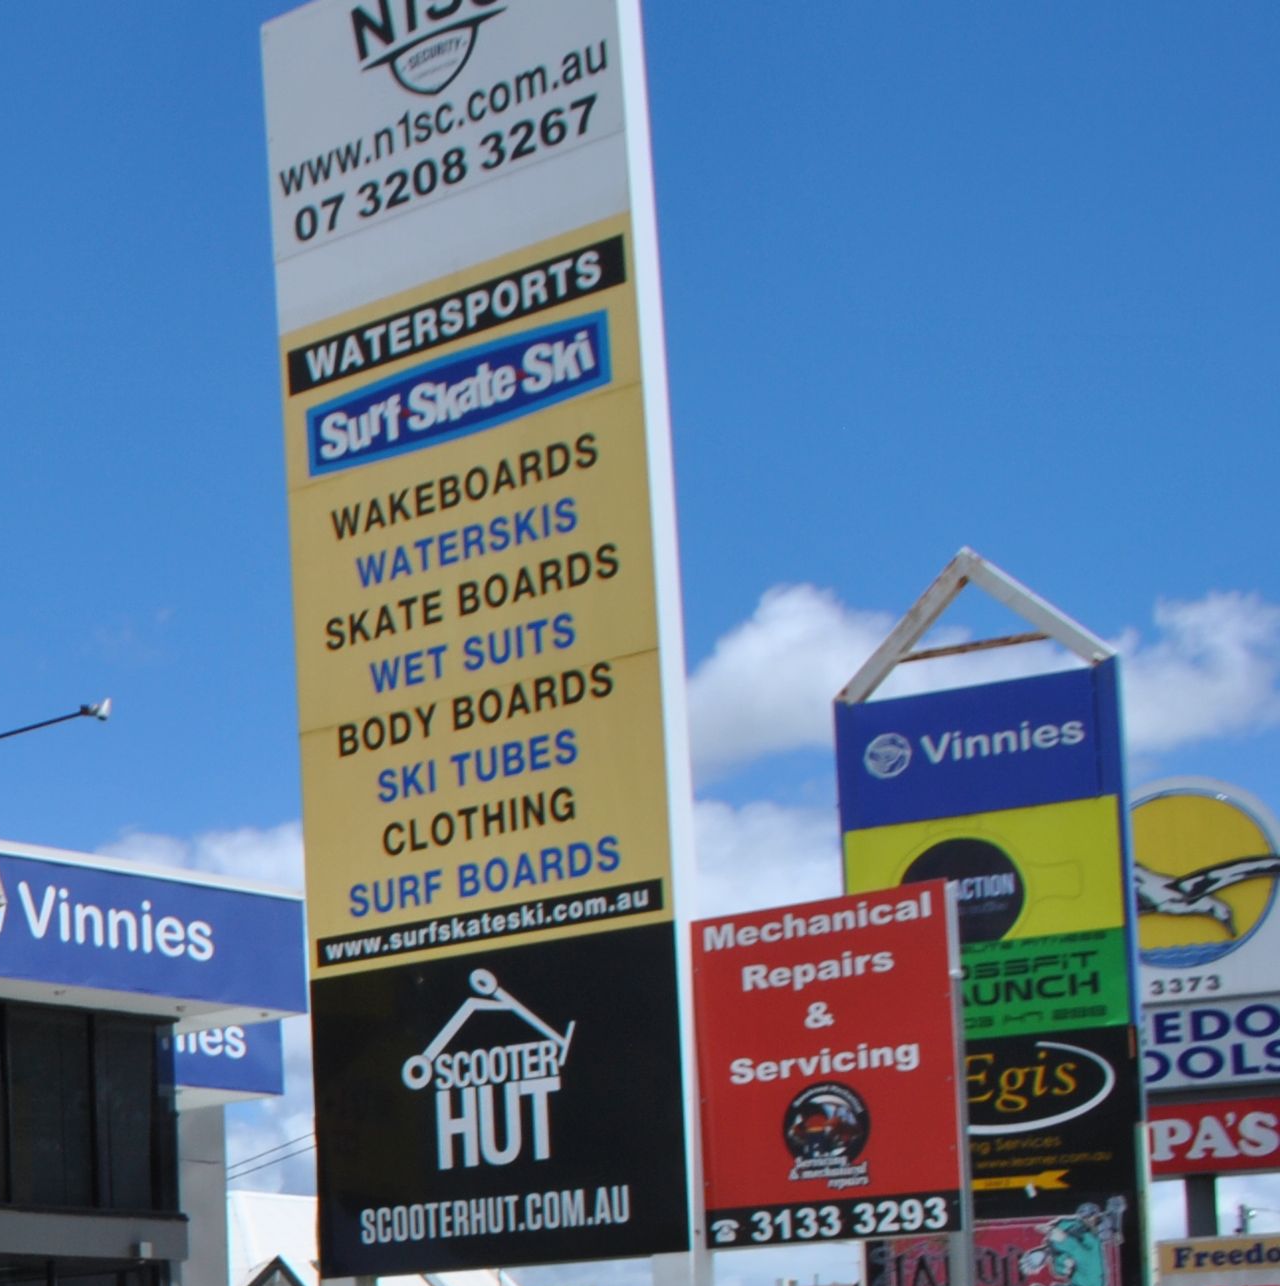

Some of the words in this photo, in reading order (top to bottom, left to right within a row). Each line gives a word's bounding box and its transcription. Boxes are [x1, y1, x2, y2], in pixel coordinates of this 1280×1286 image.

[351, 0, 500, 61] N1
[279, 39, 608, 196] www.n1sc.com.au
[294, 194, 345, 241] 07
[357, 146, 467, 218] 3208
[480, 94, 598, 171] 3267
[305, 250, 601, 382] WATERSPORTS
[320, 394, 401, 460] Surf
[407, 363, 516, 432] Skate
[522, 331, 595, 394] Ski
[332, 433, 598, 540] WAKEBOARDS
[356, 498, 578, 588] WATERSKIS
[325, 590, 444, 651] SKATE
[459, 543, 620, 616] BOARDS
[370, 645, 448, 693] WET
[463, 612, 577, 672] SUITS
[338, 704, 436, 757] BODY
[453, 661, 614, 731] BOARDS
[920, 720, 1085, 764] Vinnies
[378, 760, 437, 803] SKI
[451, 729, 579, 786] TUBES
[382, 786, 576, 857] CLOTHING
[349, 868, 444, 918] SURF
[458, 836, 621, 899] BOARDS
[18, 881, 215, 962] Vinnies
[325, 887, 649, 960] www.surfskateski.com.au
[703, 891, 932, 952] Mechanical
[742, 948, 894, 992] Repairs
[804, 1002, 834, 1029] &
[1142, 1004, 1280, 1045] EDO
[436, 1040, 560, 1091] SCOOTER
[729, 1040, 920, 1087] Servicing
[436, 1078, 561, 1170] HUT
[360, 1185, 630, 1244] SCOOTERHUT.COM.AU
[751, 1203, 842, 1240] 3133
[853, 1197, 949, 1235] 3293
